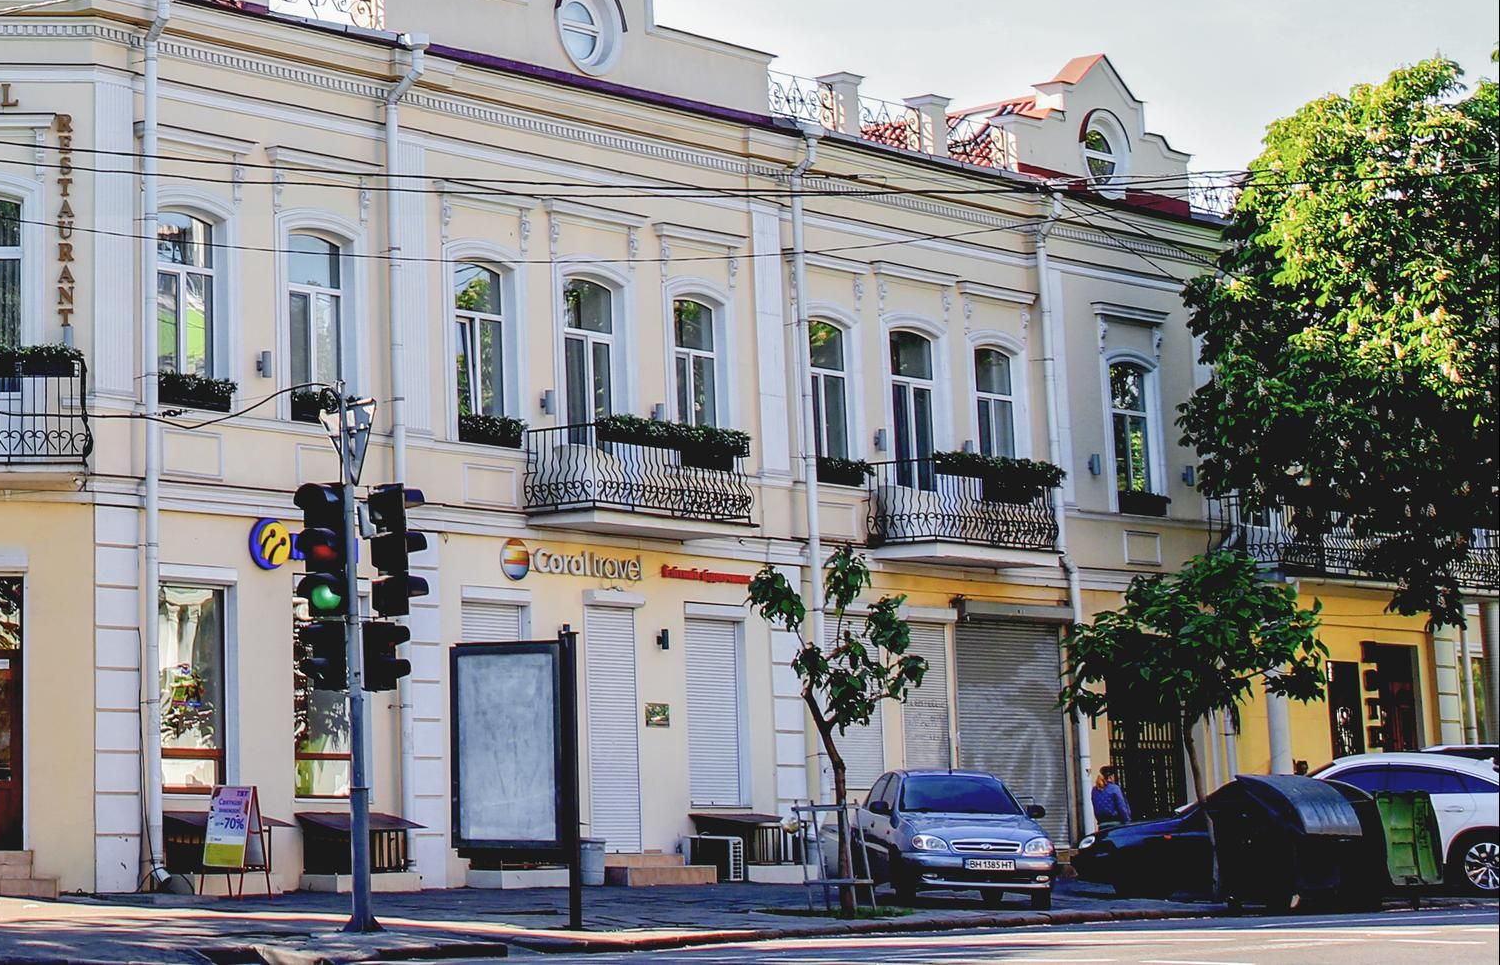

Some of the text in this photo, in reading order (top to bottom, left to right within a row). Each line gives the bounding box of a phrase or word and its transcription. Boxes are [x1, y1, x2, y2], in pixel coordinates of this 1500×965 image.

[57, 114, 75, 326] RESTAURANT
[534, 548, 591, 576] Coral
[593, 552, 642, 580] travel
[220, 817, 245, 830] -70%
